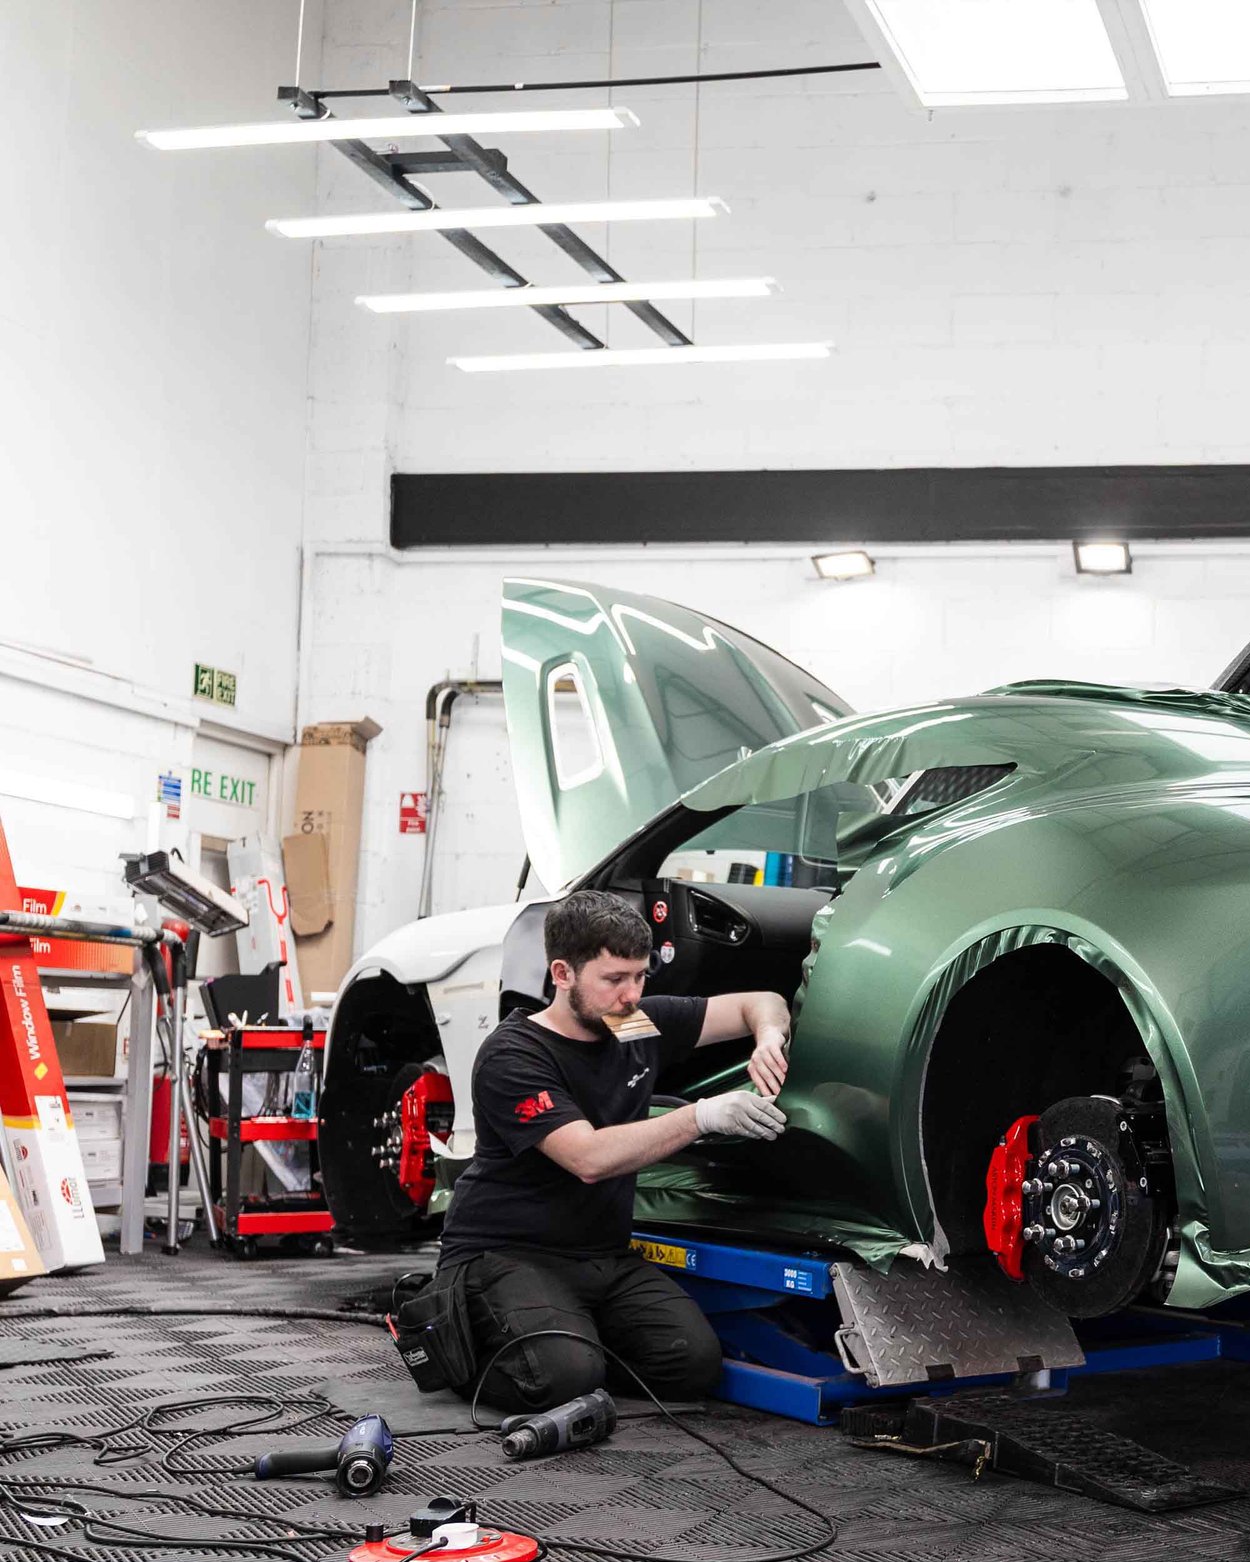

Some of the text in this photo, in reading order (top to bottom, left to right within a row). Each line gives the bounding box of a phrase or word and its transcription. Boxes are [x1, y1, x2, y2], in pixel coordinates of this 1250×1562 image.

[219, 775, 256, 806] EXIT
[23, 898, 47, 915] Film
[12, 964, 41, 1061] Window Film
[514, 1090, 555, 1123] 3M
